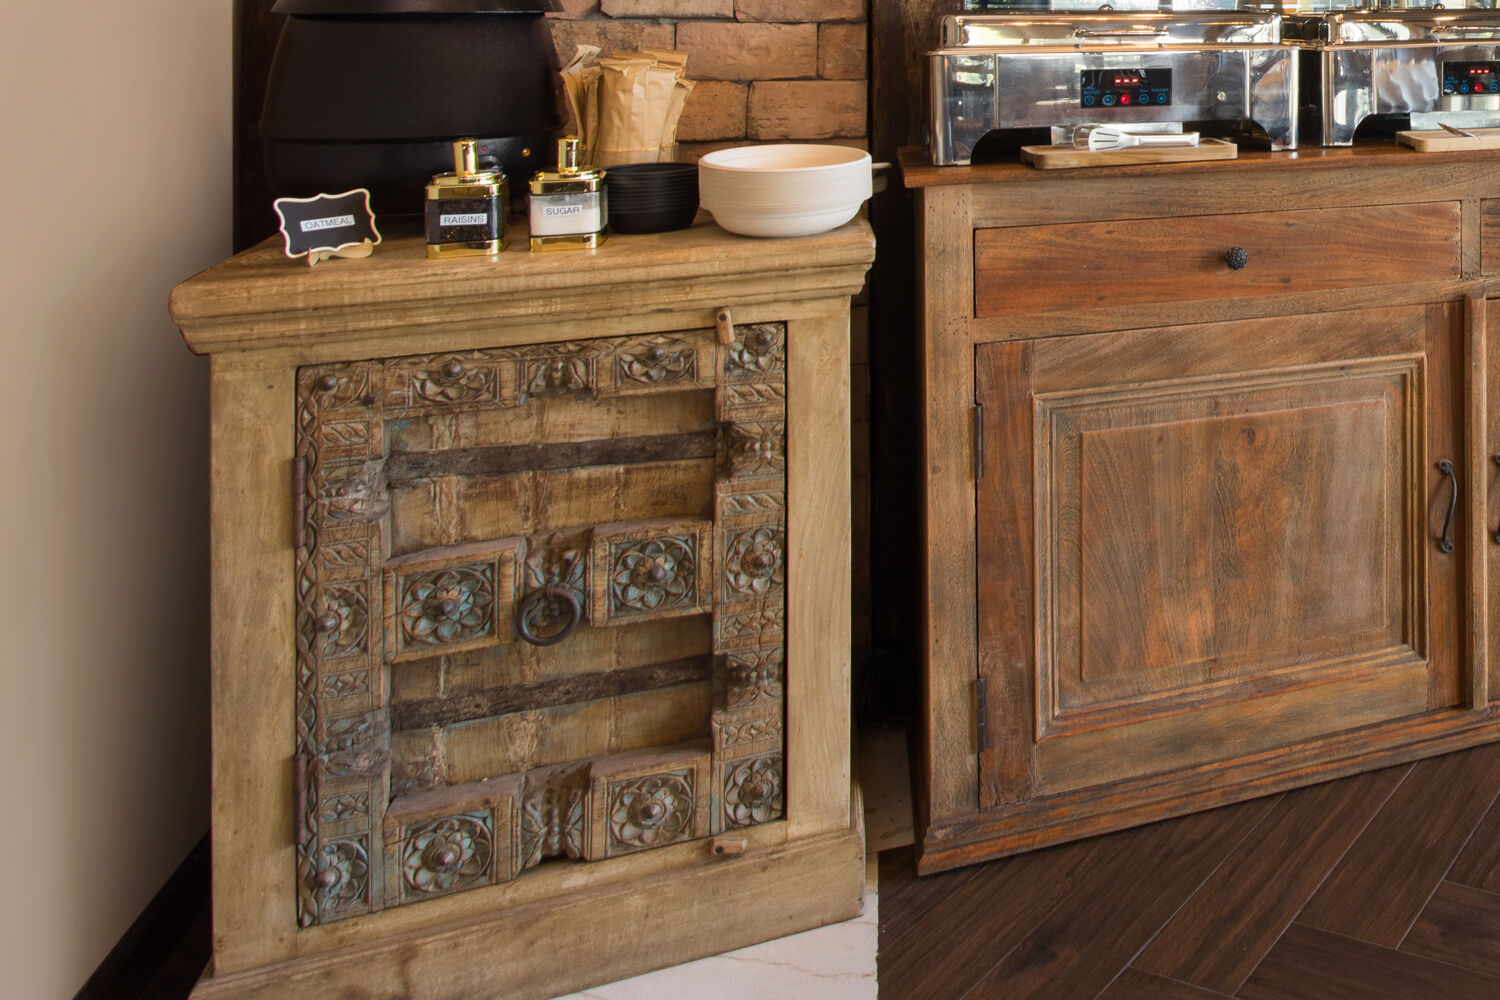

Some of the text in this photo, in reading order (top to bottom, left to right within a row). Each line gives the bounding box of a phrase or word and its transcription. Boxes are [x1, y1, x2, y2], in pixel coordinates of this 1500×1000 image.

[545, 206, 580, 216] SUGAR
[304, 216, 353, 230] OATMEAL
[443, 214, 485, 225] RAISINS
